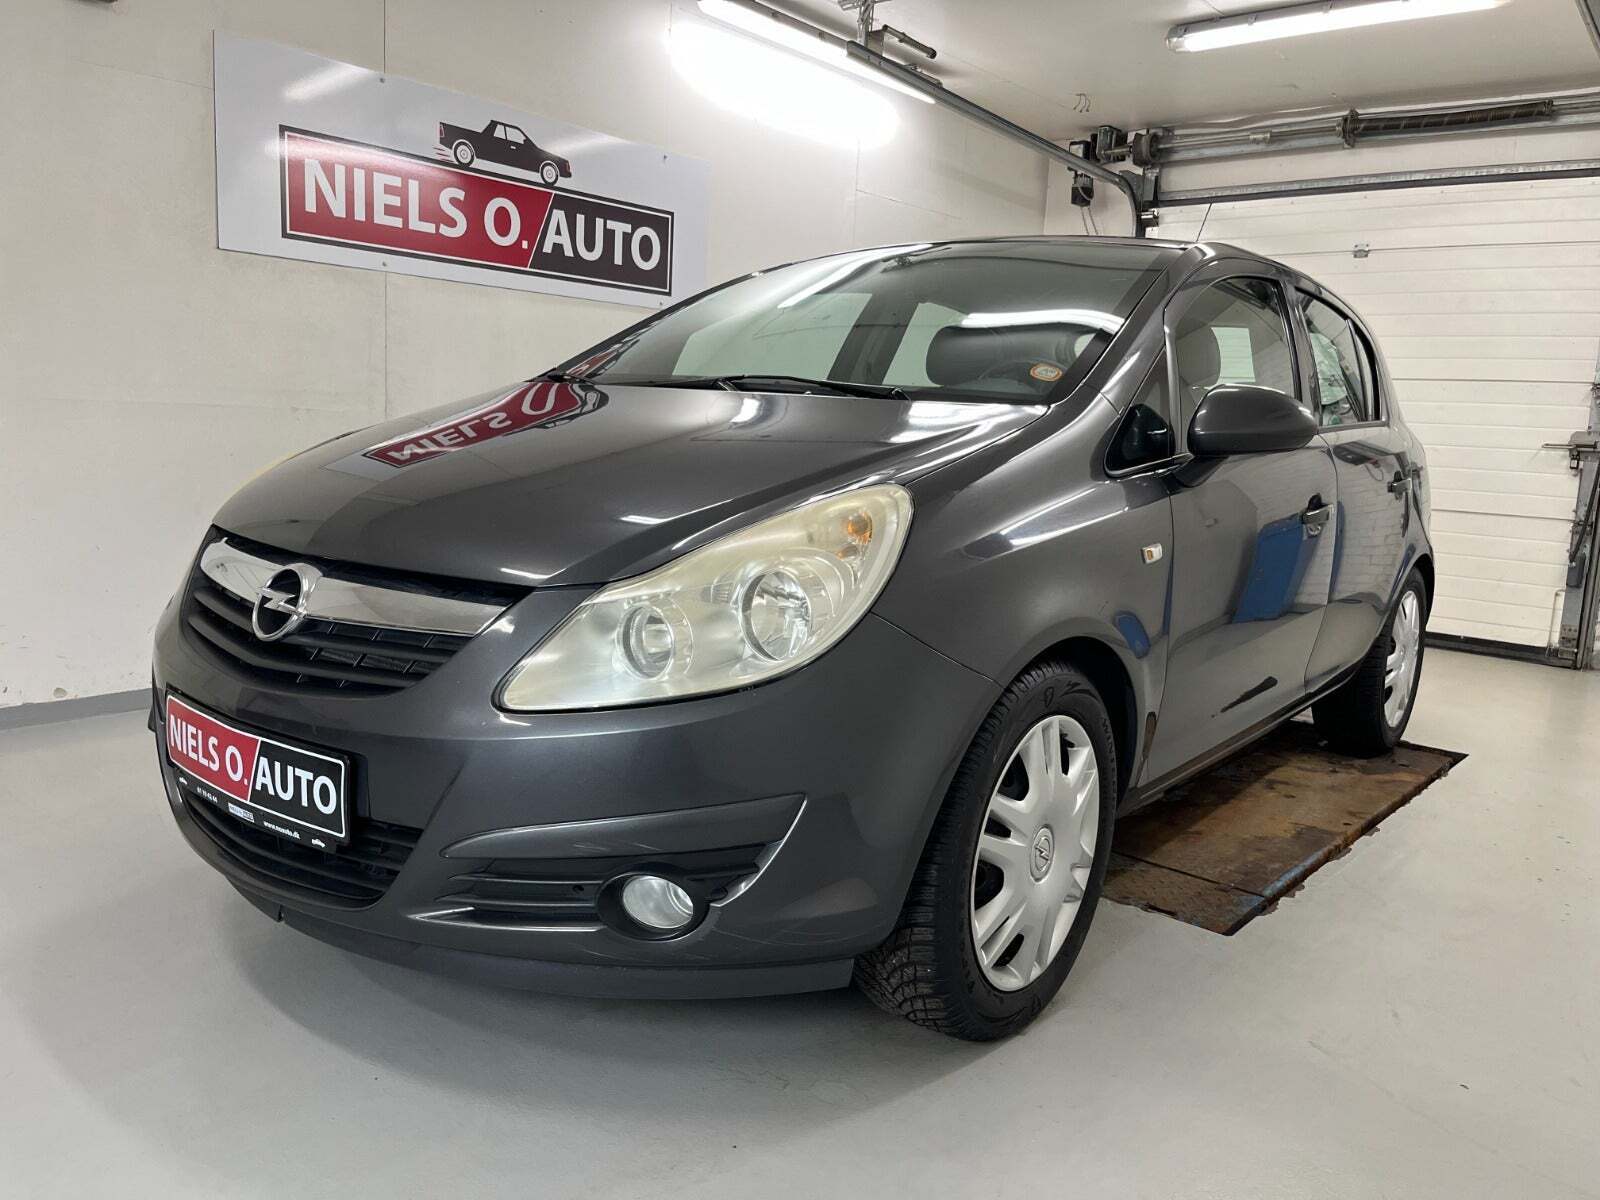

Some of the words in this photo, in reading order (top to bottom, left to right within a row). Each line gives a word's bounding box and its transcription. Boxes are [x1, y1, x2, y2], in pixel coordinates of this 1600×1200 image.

[303, 158, 467, 238] NIELS
[484, 197, 529, 249] O.
[542, 208, 661, 271] AUTO
[169, 714, 220, 772] NIELS
[225, 745, 249, 786] O.
[255, 756, 337, 815] AUTO
